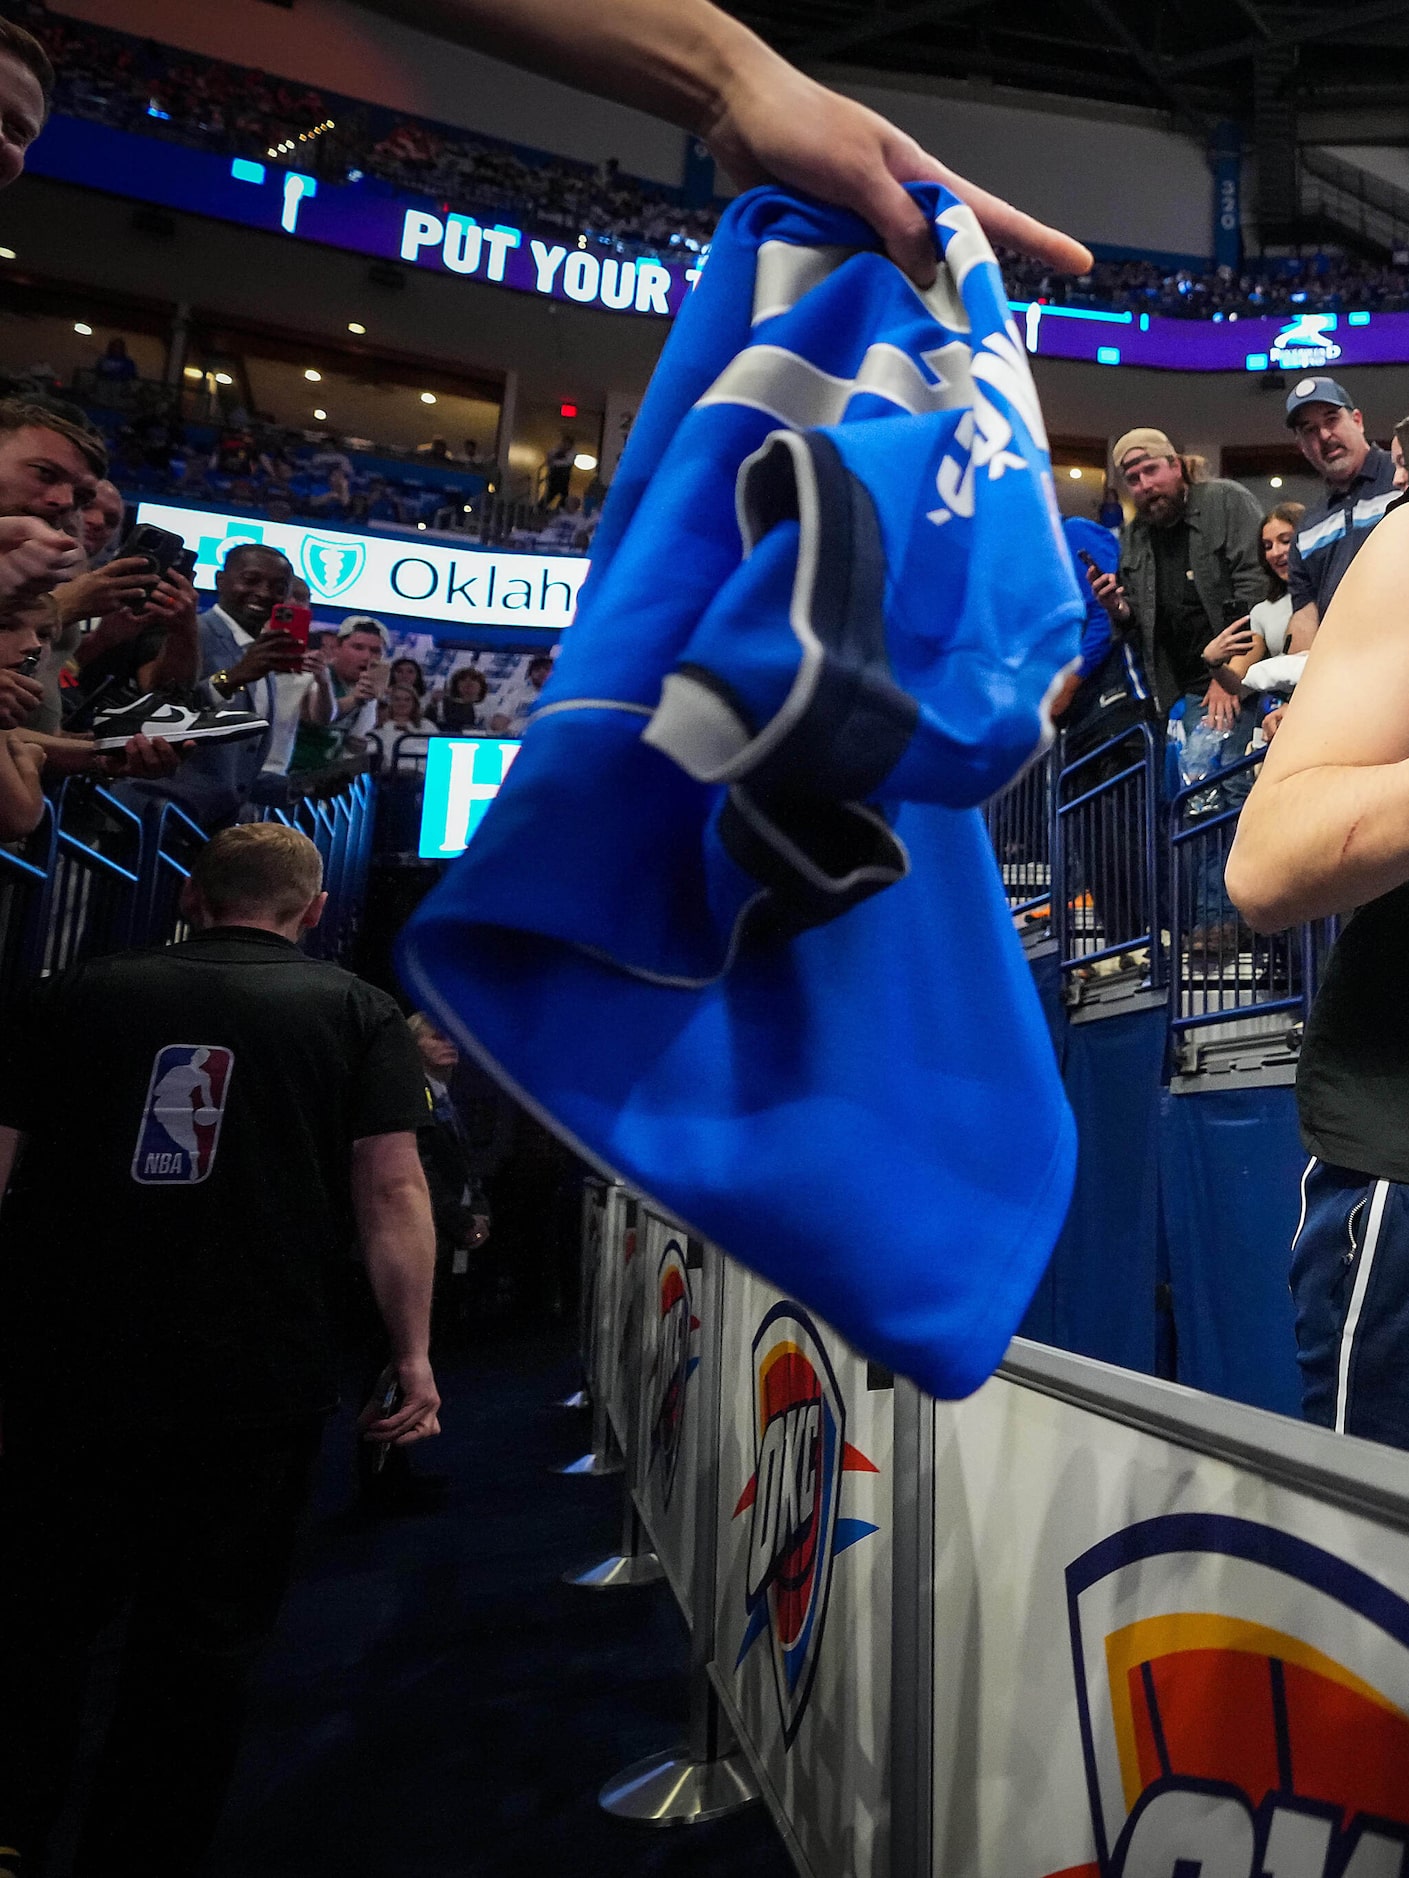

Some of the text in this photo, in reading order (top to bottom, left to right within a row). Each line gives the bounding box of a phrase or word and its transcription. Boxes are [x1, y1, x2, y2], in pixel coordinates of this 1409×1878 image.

[401, 209, 671, 315] PUT YOUR
[389, 553, 579, 612] Oklah
[144, 1152, 183, 1174] NBA
[749, 1403, 820, 1596] OKC
